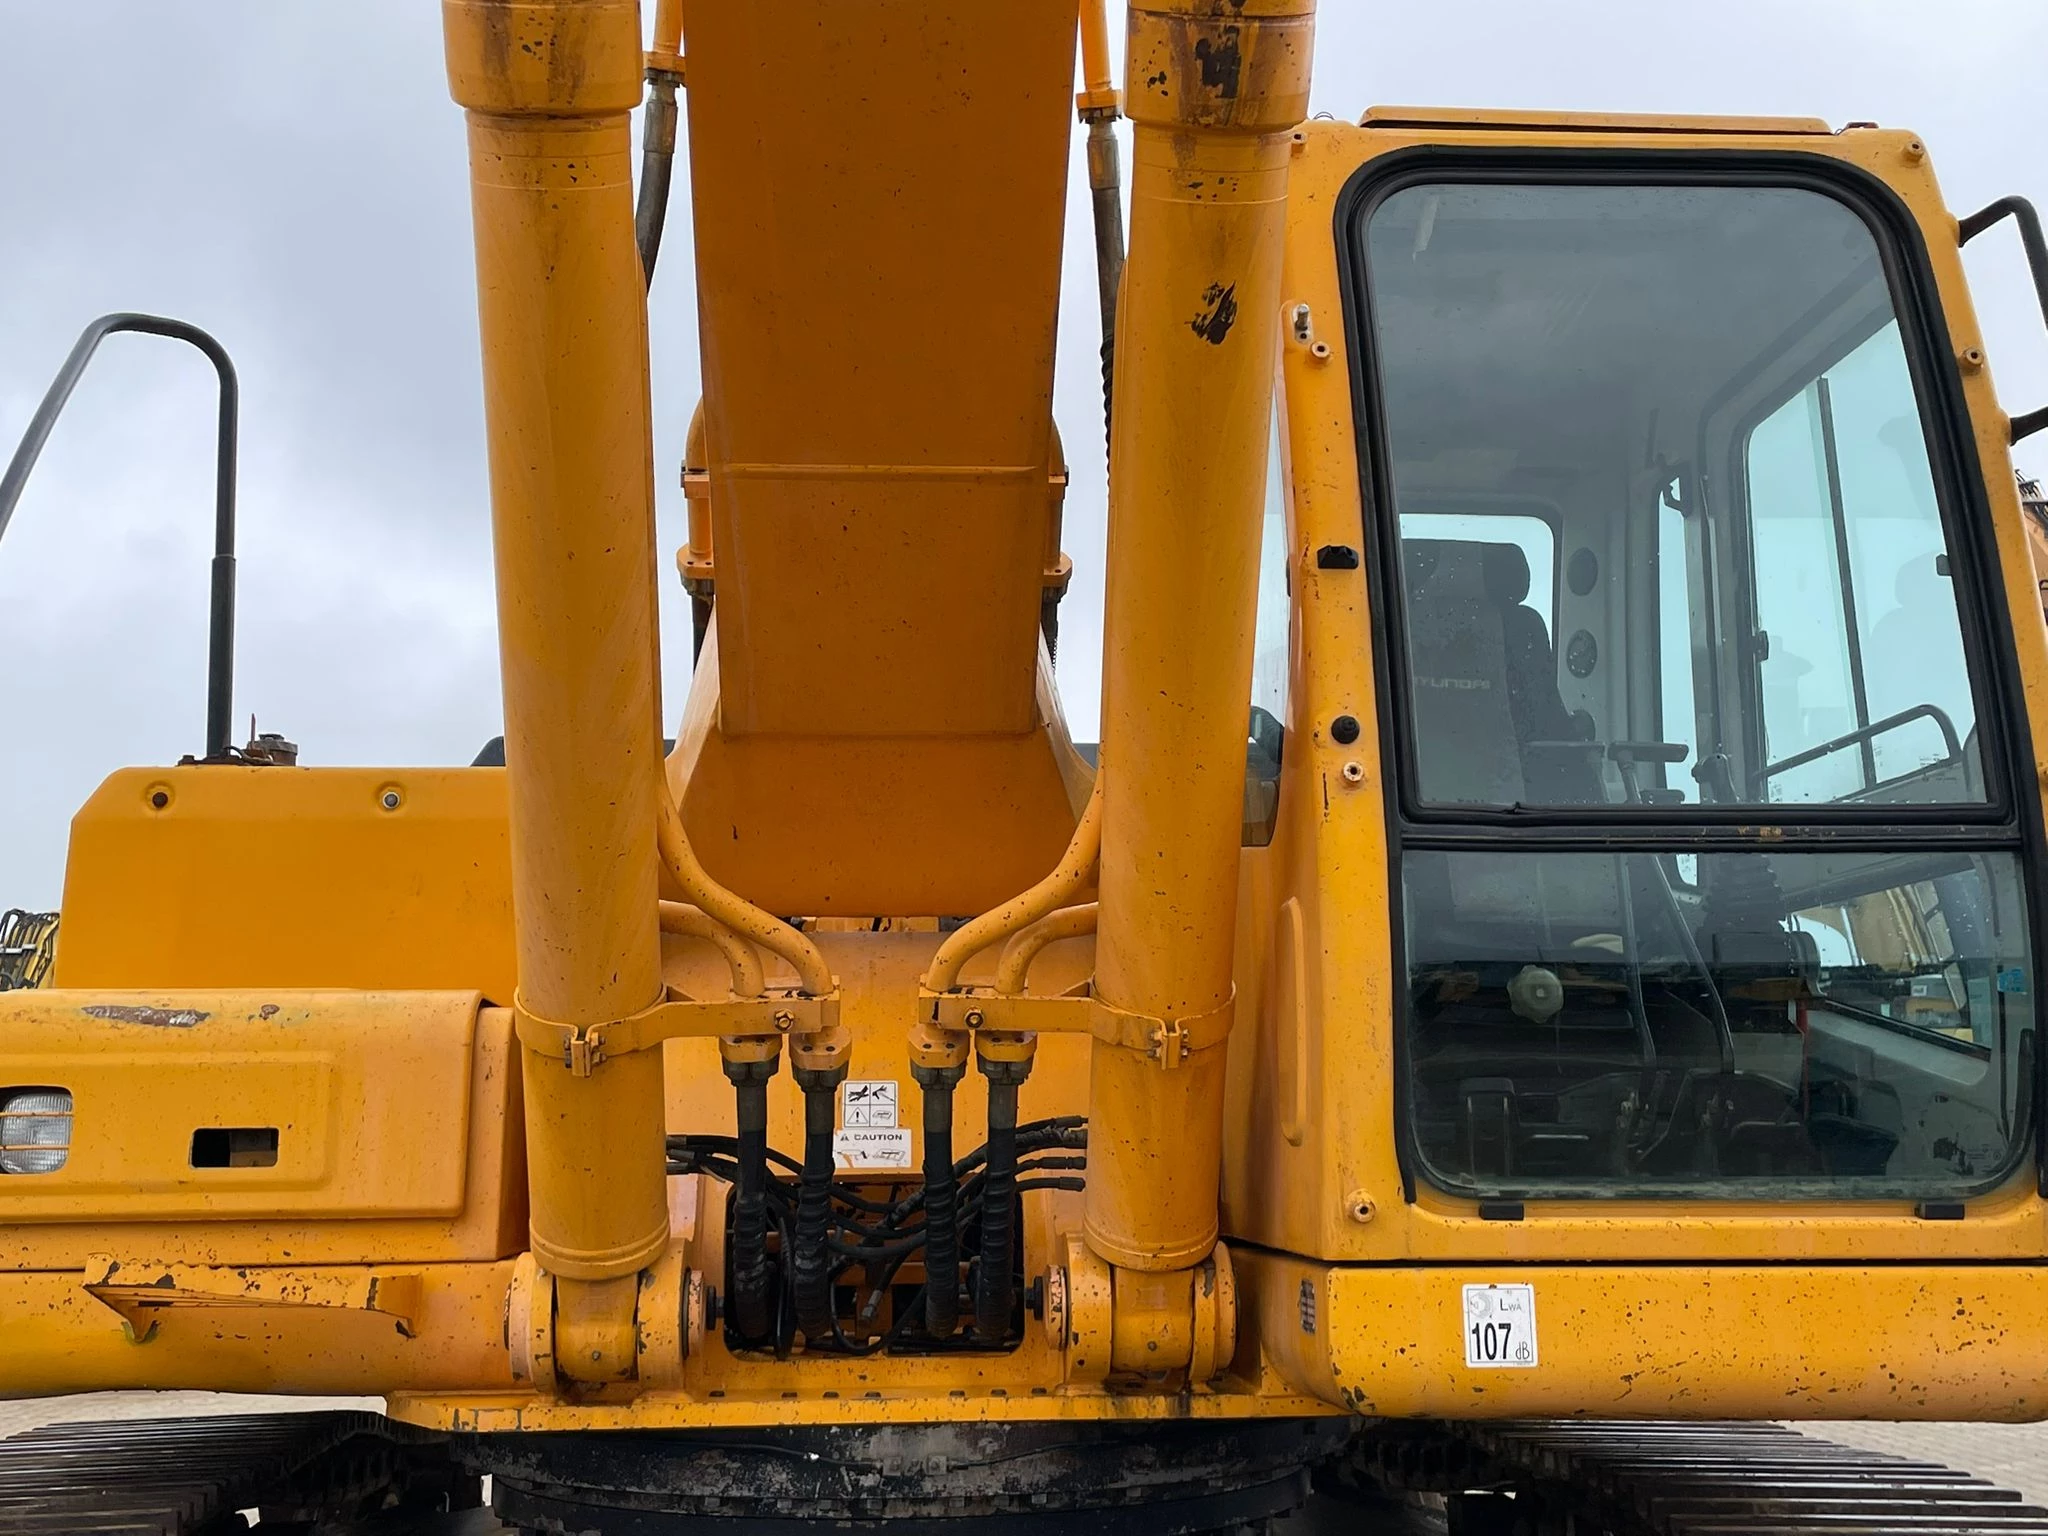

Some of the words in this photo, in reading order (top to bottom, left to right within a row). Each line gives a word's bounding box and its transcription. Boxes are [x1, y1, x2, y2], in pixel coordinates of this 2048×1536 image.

[854, 1133, 903, 1141] CAUTION
[1471, 1322, 1512, 1360] 107
[1515, 1341, 1530, 1360] dB
